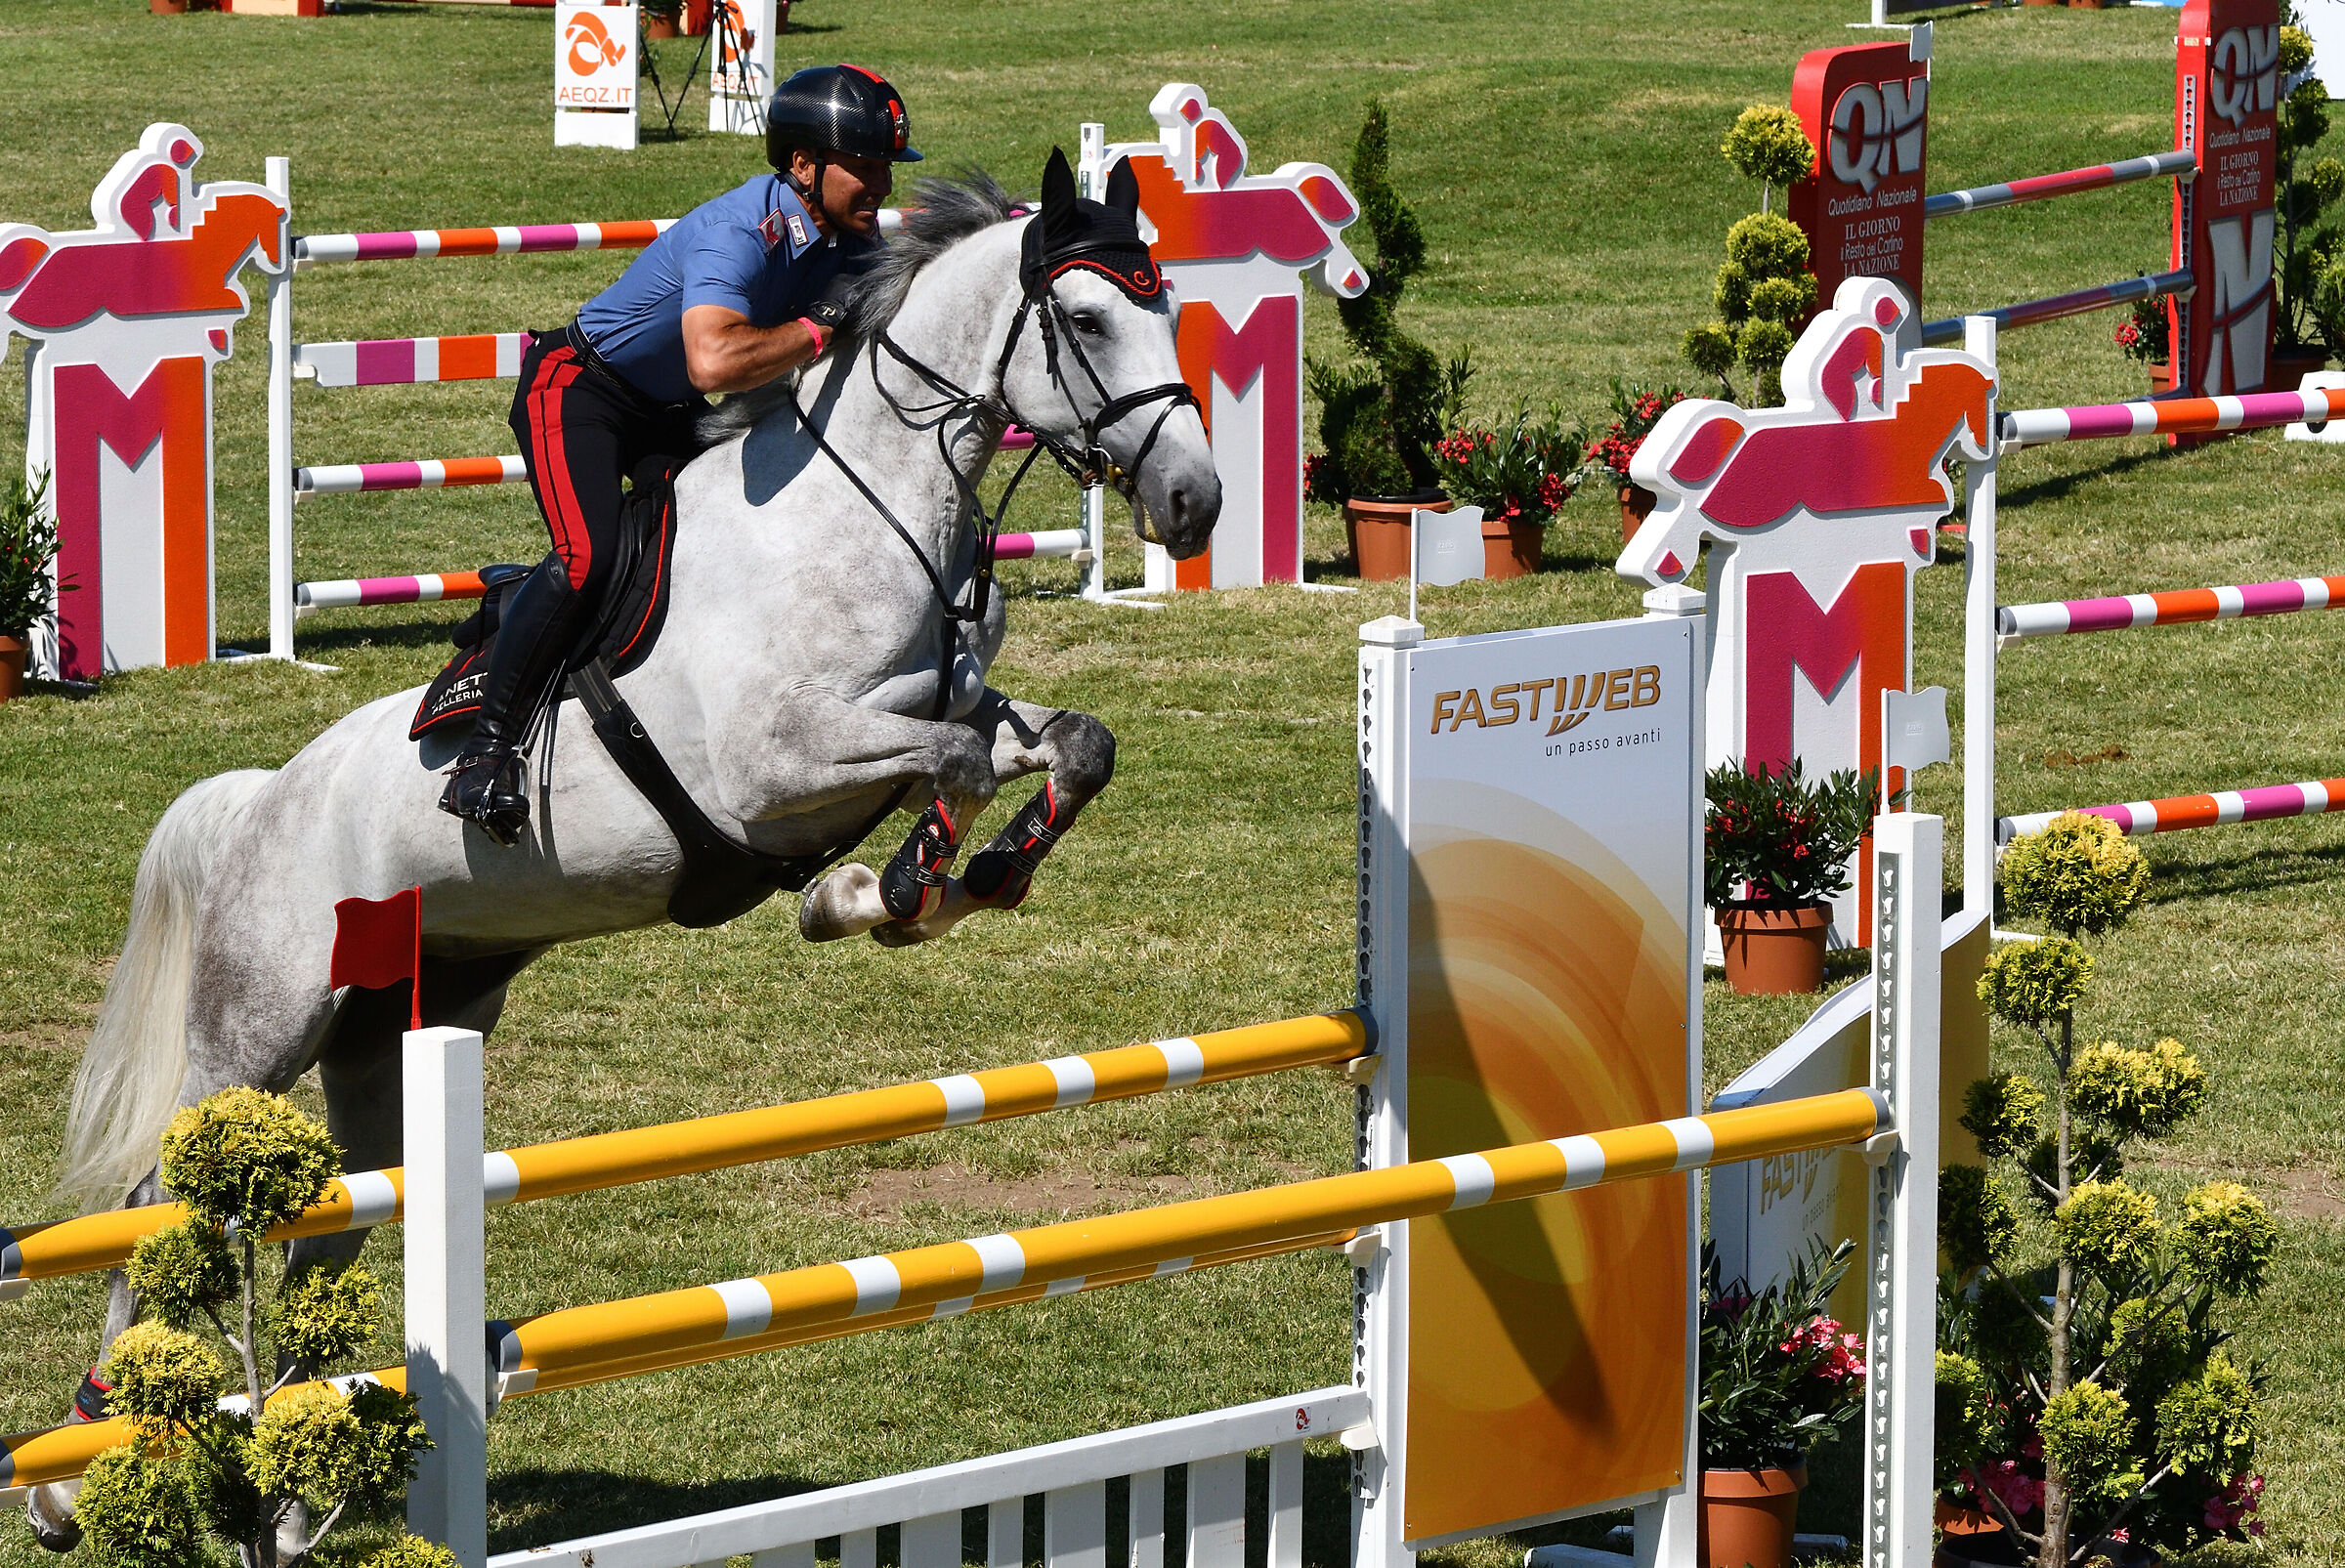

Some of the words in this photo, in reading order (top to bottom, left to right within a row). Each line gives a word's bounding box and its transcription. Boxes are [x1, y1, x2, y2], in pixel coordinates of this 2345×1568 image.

[2211, 23, 2280, 130] QN
[559, 87, 632, 103] AEQZ.IT
[1827, 75, 1928, 194] QN
[2220, 156, 2228, 171] IL
[2230, 150, 2259, 169] GIORNO
[1828, 194, 1872, 216] Quotidiano
[1877, 186, 1917, 208] Nazionale
[2220, 191, 2228, 206] LA
[2230, 186, 2258, 204] NAZIONE
[1845, 224, 1855, 240] IL
[1858, 216, 1900, 237] GIORNO
[1845, 241, 1865, 260] Resto
[1877, 234, 1903, 254] Carlino
[1844, 262, 1855, 278] LA
[1858, 254, 1899, 275] NAZIONE
[1430, 664, 1660, 737] FASTWEB
[1545, 743, 1561, 757] un
[1569, 736, 1610, 757] passo
[1616, 727, 1661, 747] avanti
